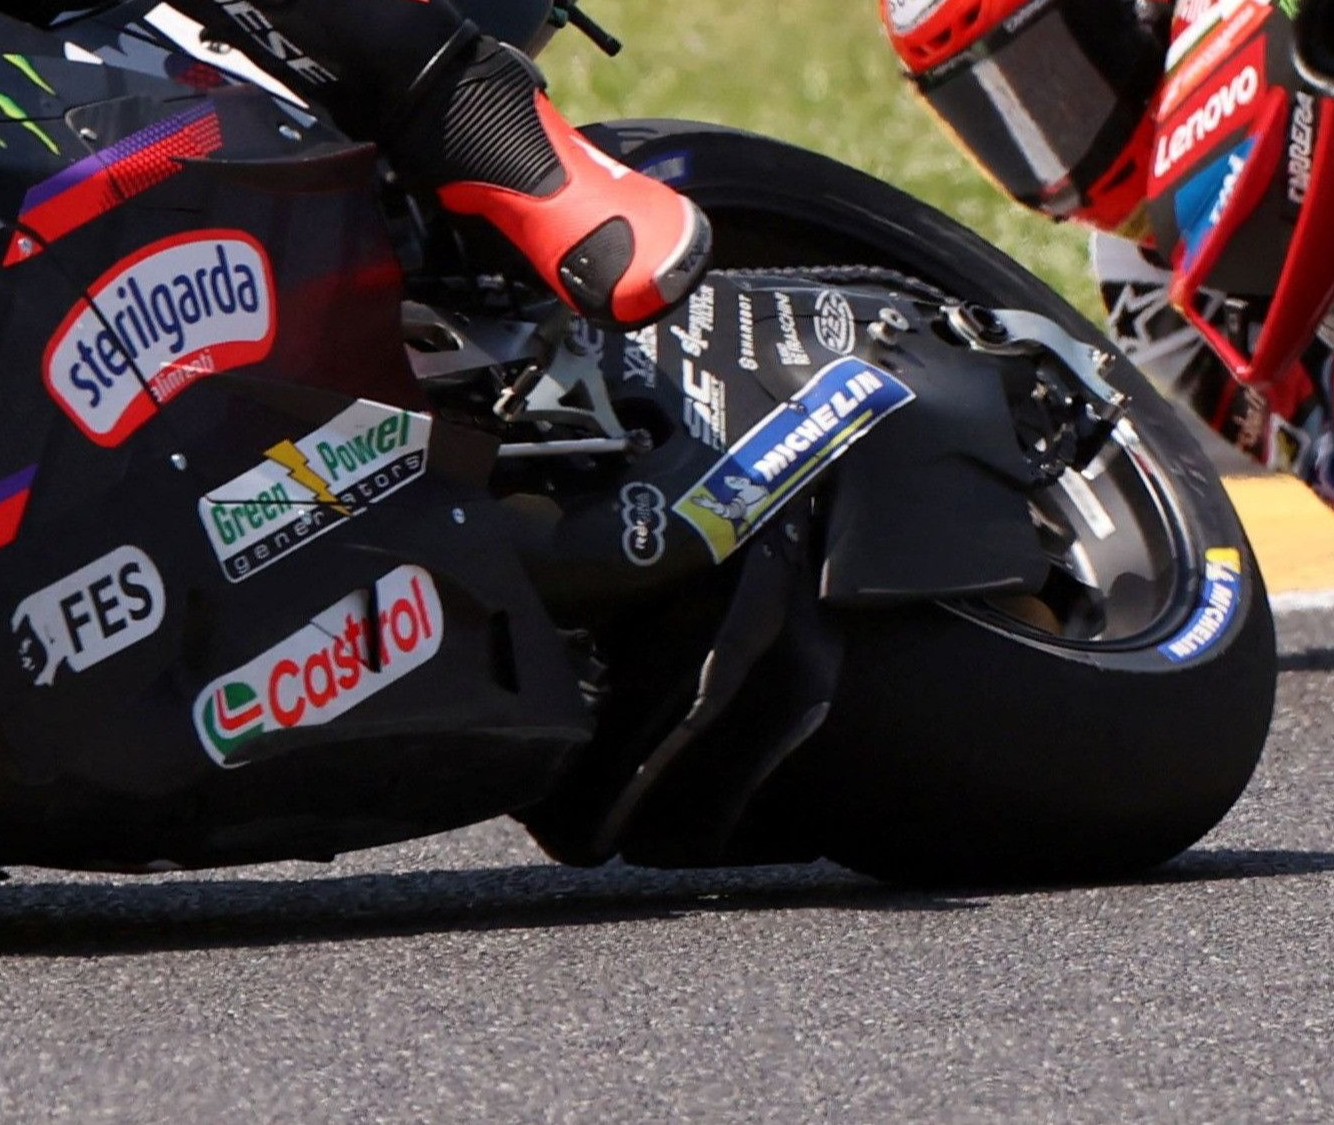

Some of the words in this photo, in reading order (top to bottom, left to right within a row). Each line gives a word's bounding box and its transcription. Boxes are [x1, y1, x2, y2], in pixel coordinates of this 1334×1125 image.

[1154, 65, 1258, 178] Lenovo
[70, 245, 259, 408] sterilgarda
[212, 480, 293, 546] Green
[318, 412, 413, 480] Power
[752, 370, 884, 482] MICHELIN
[60, 561, 154, 656] FES
[269, 576, 432, 728] Castrol
[1168, 582, 1233, 658] MICHELIN
